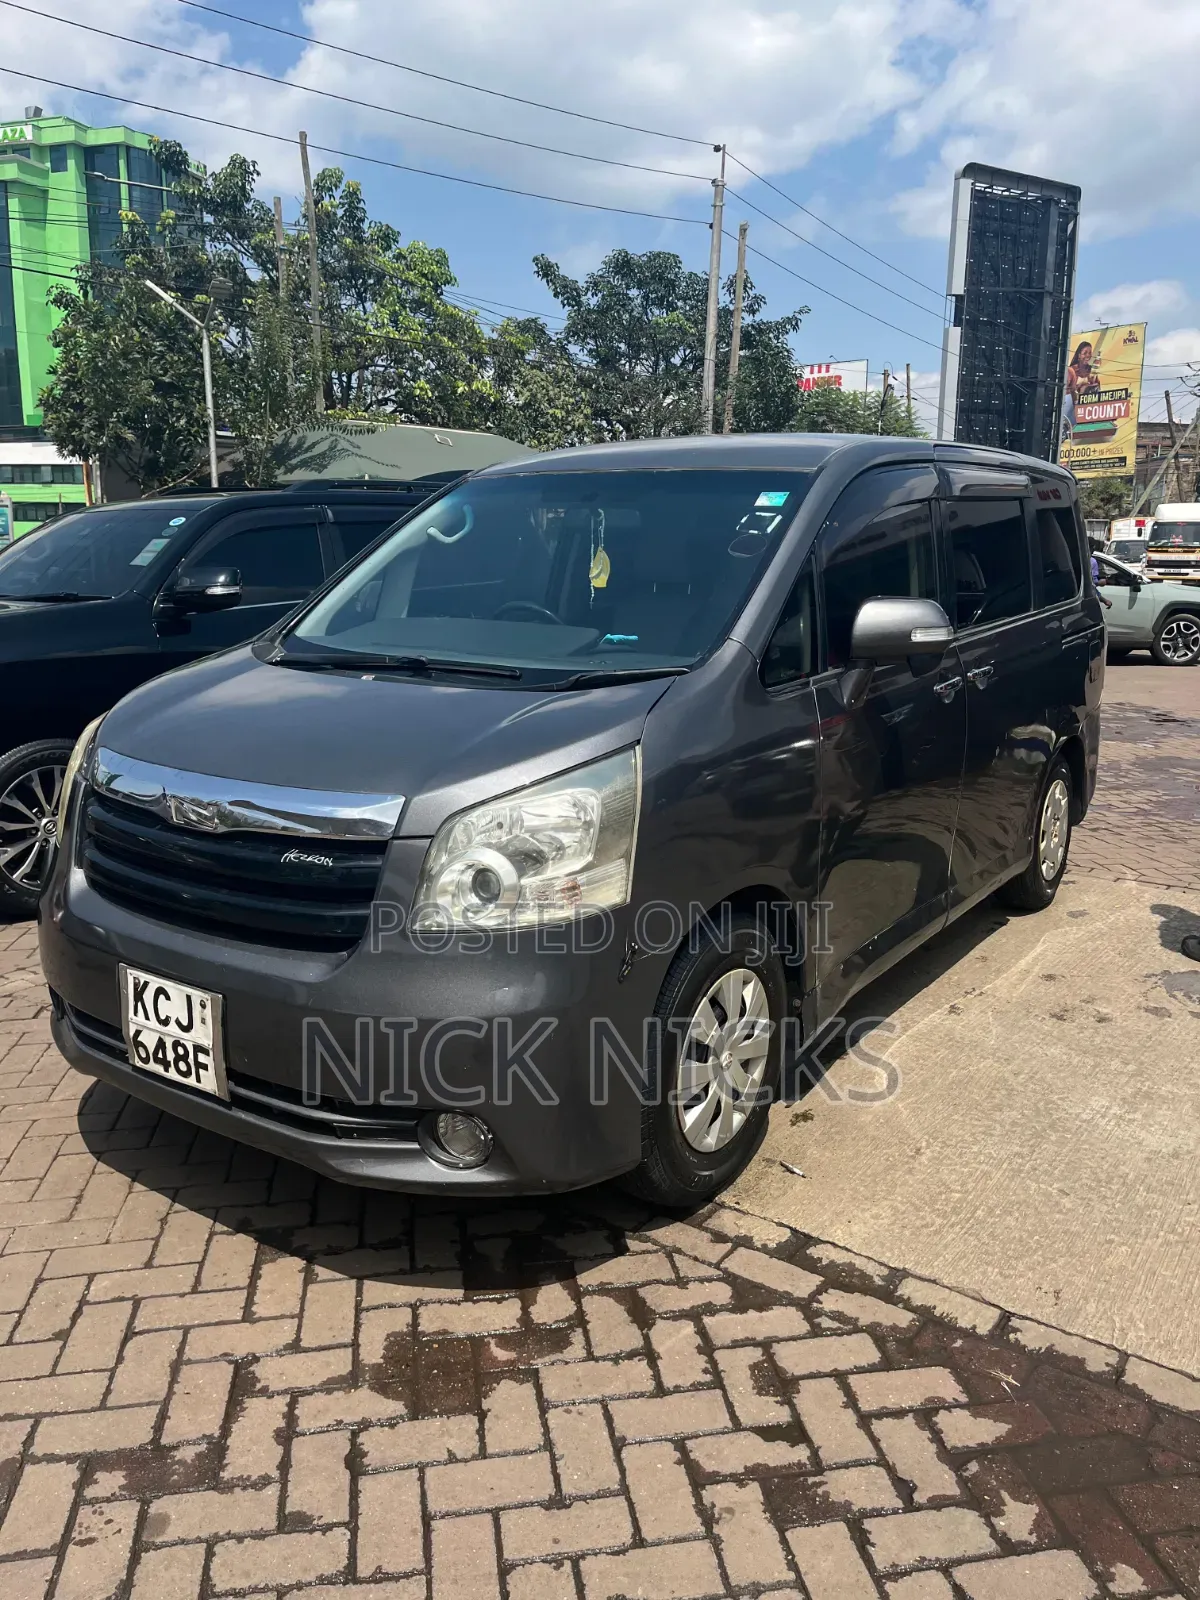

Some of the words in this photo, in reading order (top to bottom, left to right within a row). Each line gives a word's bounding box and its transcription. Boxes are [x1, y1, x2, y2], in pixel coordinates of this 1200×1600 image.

[1080, 393, 1099, 404] FORM
[1085, 402, 1127, 420] COUNTY
[132, 976, 194, 1033] KCJ
[132, 1029, 211, 1084] 648F
